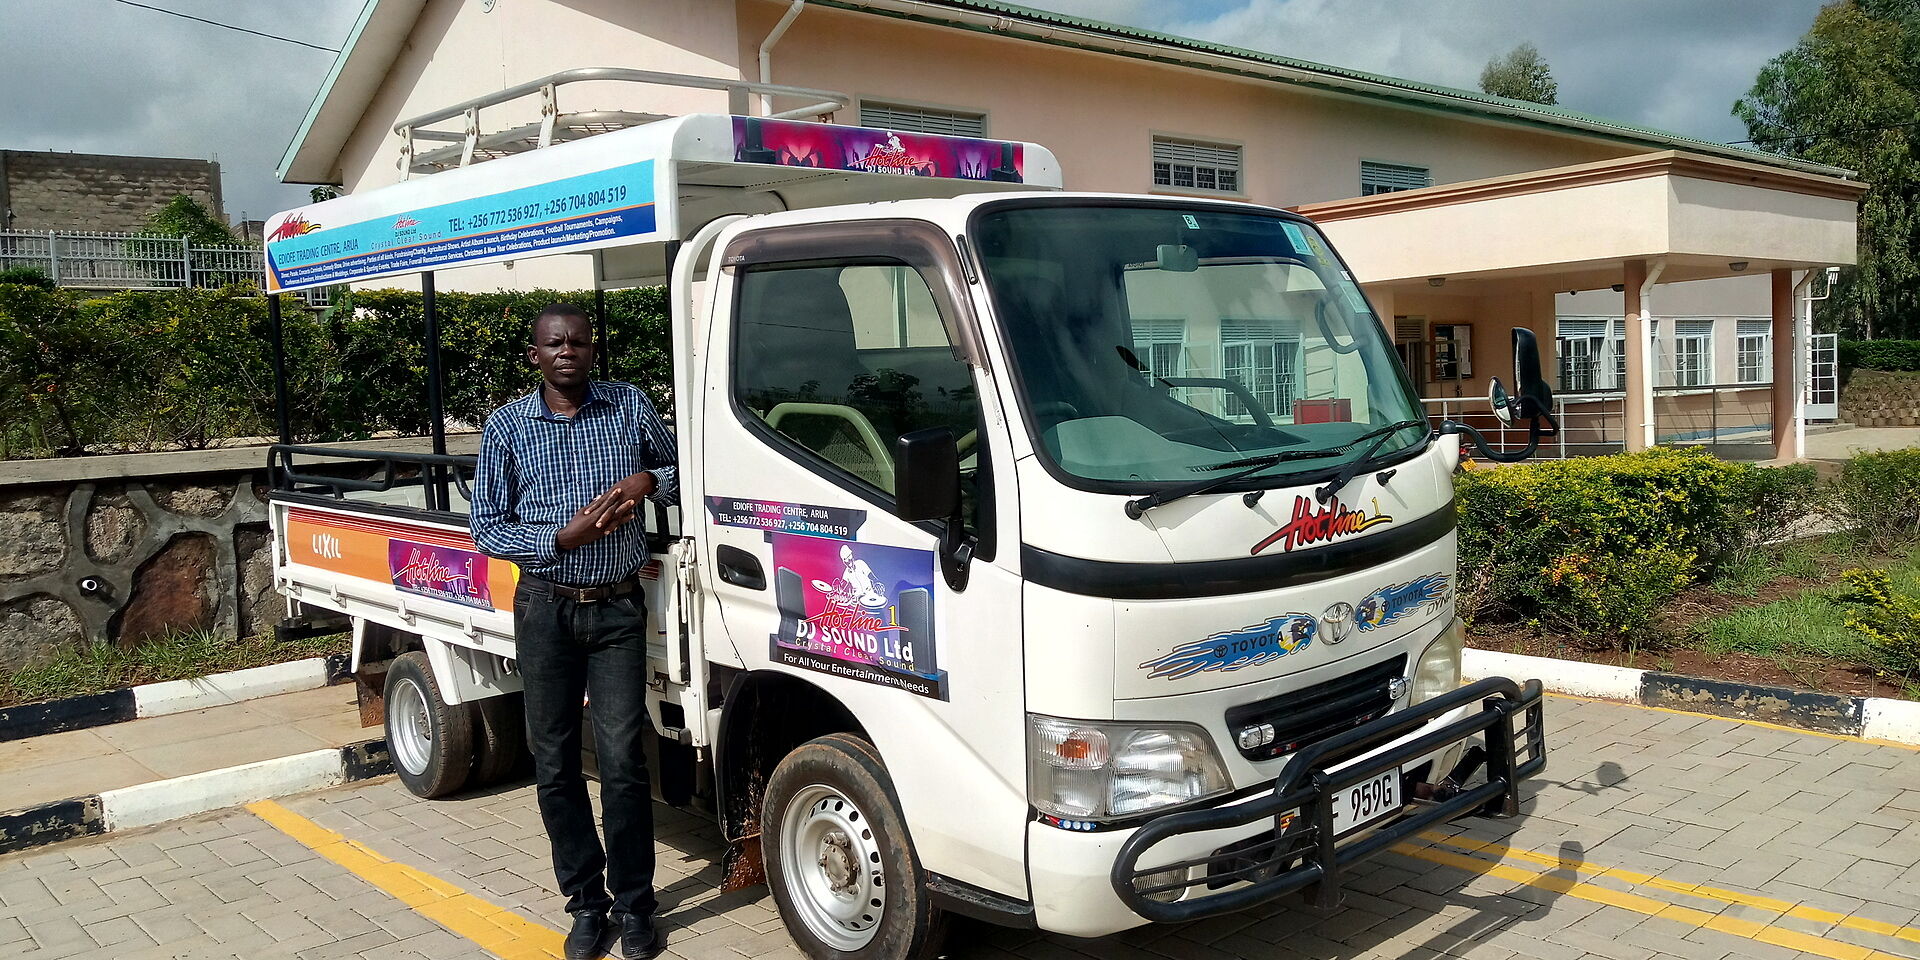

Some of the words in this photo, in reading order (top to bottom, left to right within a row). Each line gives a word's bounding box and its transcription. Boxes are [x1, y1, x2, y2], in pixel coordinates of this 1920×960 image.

[878, 166, 901, 174] SOUND
[449, 218, 464, 232] TEL:
[468, 214, 488, 228] +256
[490, 211, 505, 226] 772
[508, 208, 522, 222] 536
[524, 203, 542, 219] 927,
[544, 198, 566, 215] +256
[569, 194, 586, 211] 704
[588, 190, 605, 207] 804
[608, 185, 626, 203] 519
[371, 240, 393, 250] Crystal
[397, 236, 415, 244] Clear
[419, 232, 441, 240] Sound
[426, 243, 447, 254] Agricultural
[471, 237, 483, 246] Album
[483, 234, 500, 245] Launch,
[500, 231, 516, 242] Birthday
[517, 226, 545, 239] Celebrations,
[545, 223, 563, 234] Football
[563, 218, 594, 232] Tournaments,
[594, 212, 623, 226] Campaigns,
[296, 247, 319, 261] TRADING
[343, 238, 358, 252] ARUA
[408, 257, 422, 265] Funeral
[422, 253, 447, 263] Remembrance
[447, 250, 463, 260] Services,
[463, 247, 483, 257] Christmas
[505, 240, 532, 251] Celebrations,
[532, 237, 550, 246] Product
[733, 502, 753, 512] EDIOFE
[754, 504, 781, 514] TRADING
[783, 506, 808, 518] CENTRE,
[810, 509, 828, 519] ARUA
[1372, 496, 1382, 517] 1
[719, 513, 732, 522] TEL:
[733, 515, 748, 524] +256
[749, 516, 760, 525] 772
[761, 518, 772, 527] 536
[774, 519, 788, 529] 927,
[788, 521, 805, 530] +256
[806, 523, 819, 532] 704
[820, 524, 833, 534] 804
[834, 526, 847, 536] 519
[312, 532, 342, 559] LIXIL
[466, 558, 478, 594] 1
[1392, 588, 1423, 608] TOYOTA
[1426, 589, 1452, 616] DYNA
[888, 606, 898, 626] 1
[796, 619, 816, 640] DJ
[821, 626, 877, 654] SOUND
[884, 638, 914, 663] Ltd
[1231, 631, 1284, 653] TOYOTA
[795, 638, 837, 653] Crystal
[844, 647, 873, 661] Clear
[879, 657, 914, 672] Sound
[784, 653, 797, 664] For
[798, 656, 809, 666] All
[811, 659, 830, 670] Your
[900, 679, 929, 694] Needs
[1351, 774, 1392, 822] 959G
